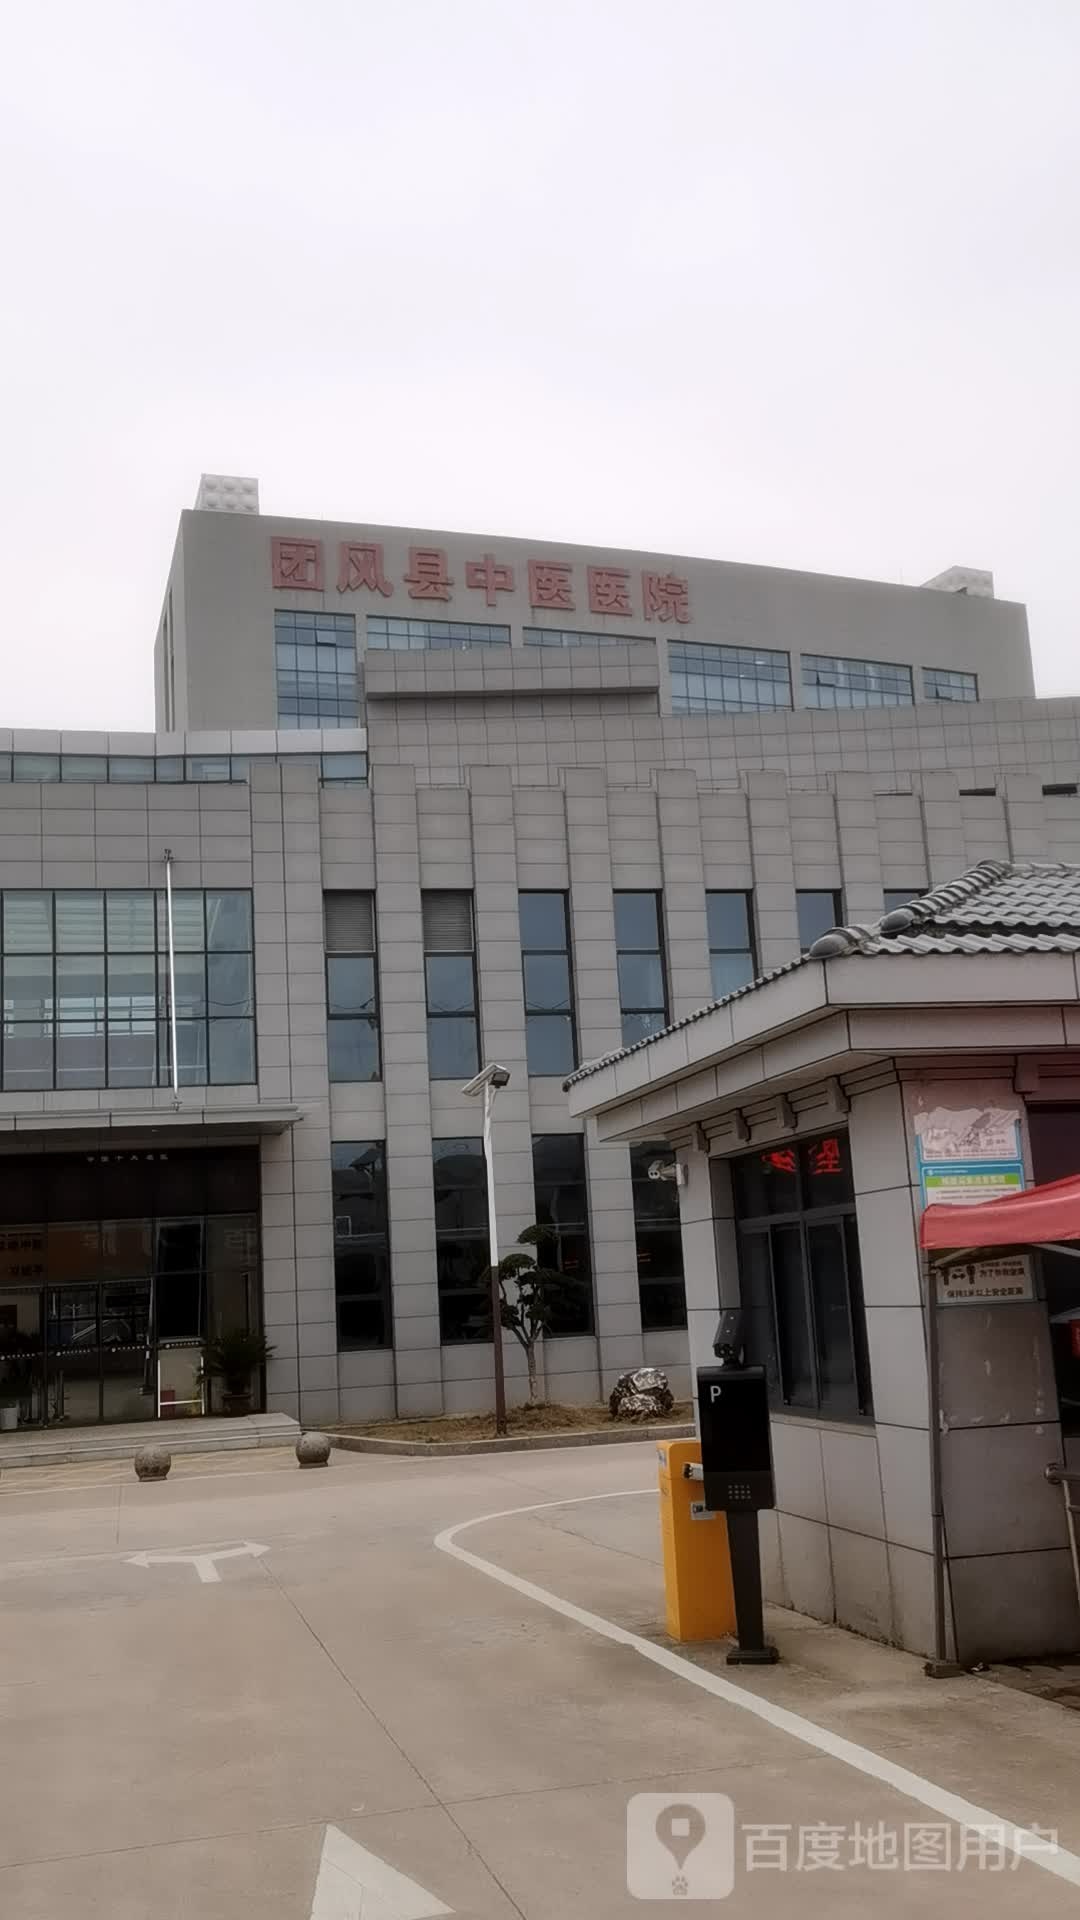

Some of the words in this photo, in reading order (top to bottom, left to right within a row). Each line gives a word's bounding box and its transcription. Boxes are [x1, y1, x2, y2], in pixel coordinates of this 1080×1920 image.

[271, 536, 693, 624] 团风县中医医院
[710, 1385, 722, 1403] P
